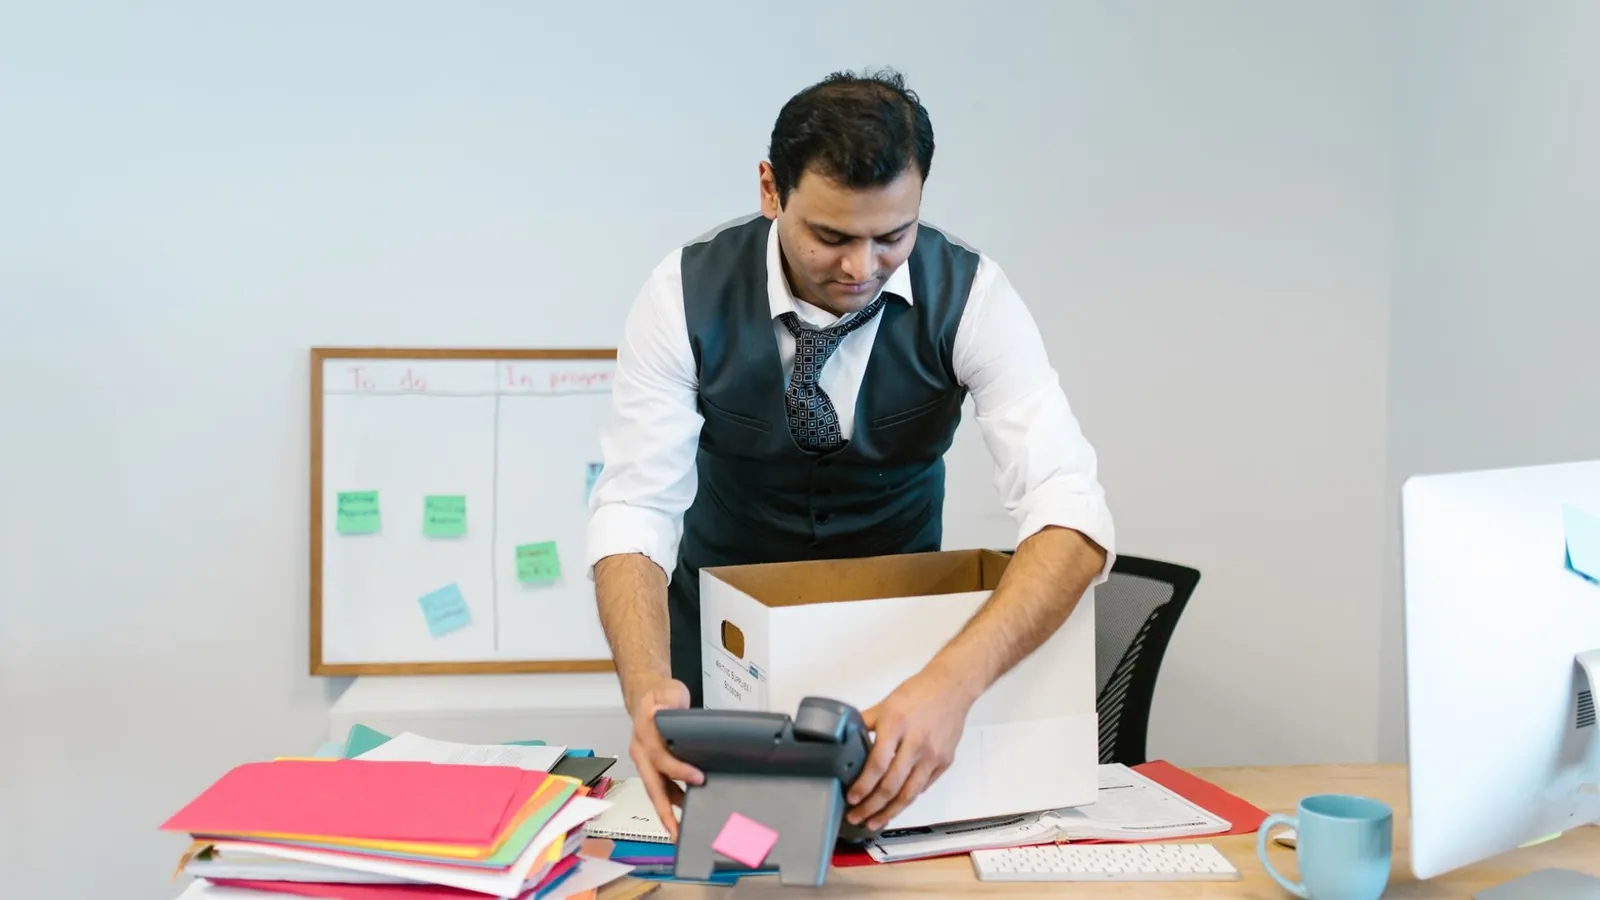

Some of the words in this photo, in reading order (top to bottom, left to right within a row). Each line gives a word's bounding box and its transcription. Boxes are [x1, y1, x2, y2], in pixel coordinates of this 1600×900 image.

[347, 366, 376, 391] To
[400, 368, 428, 391] do
[506, 364, 533, 388] In
[549, 369, 614, 389] progre
